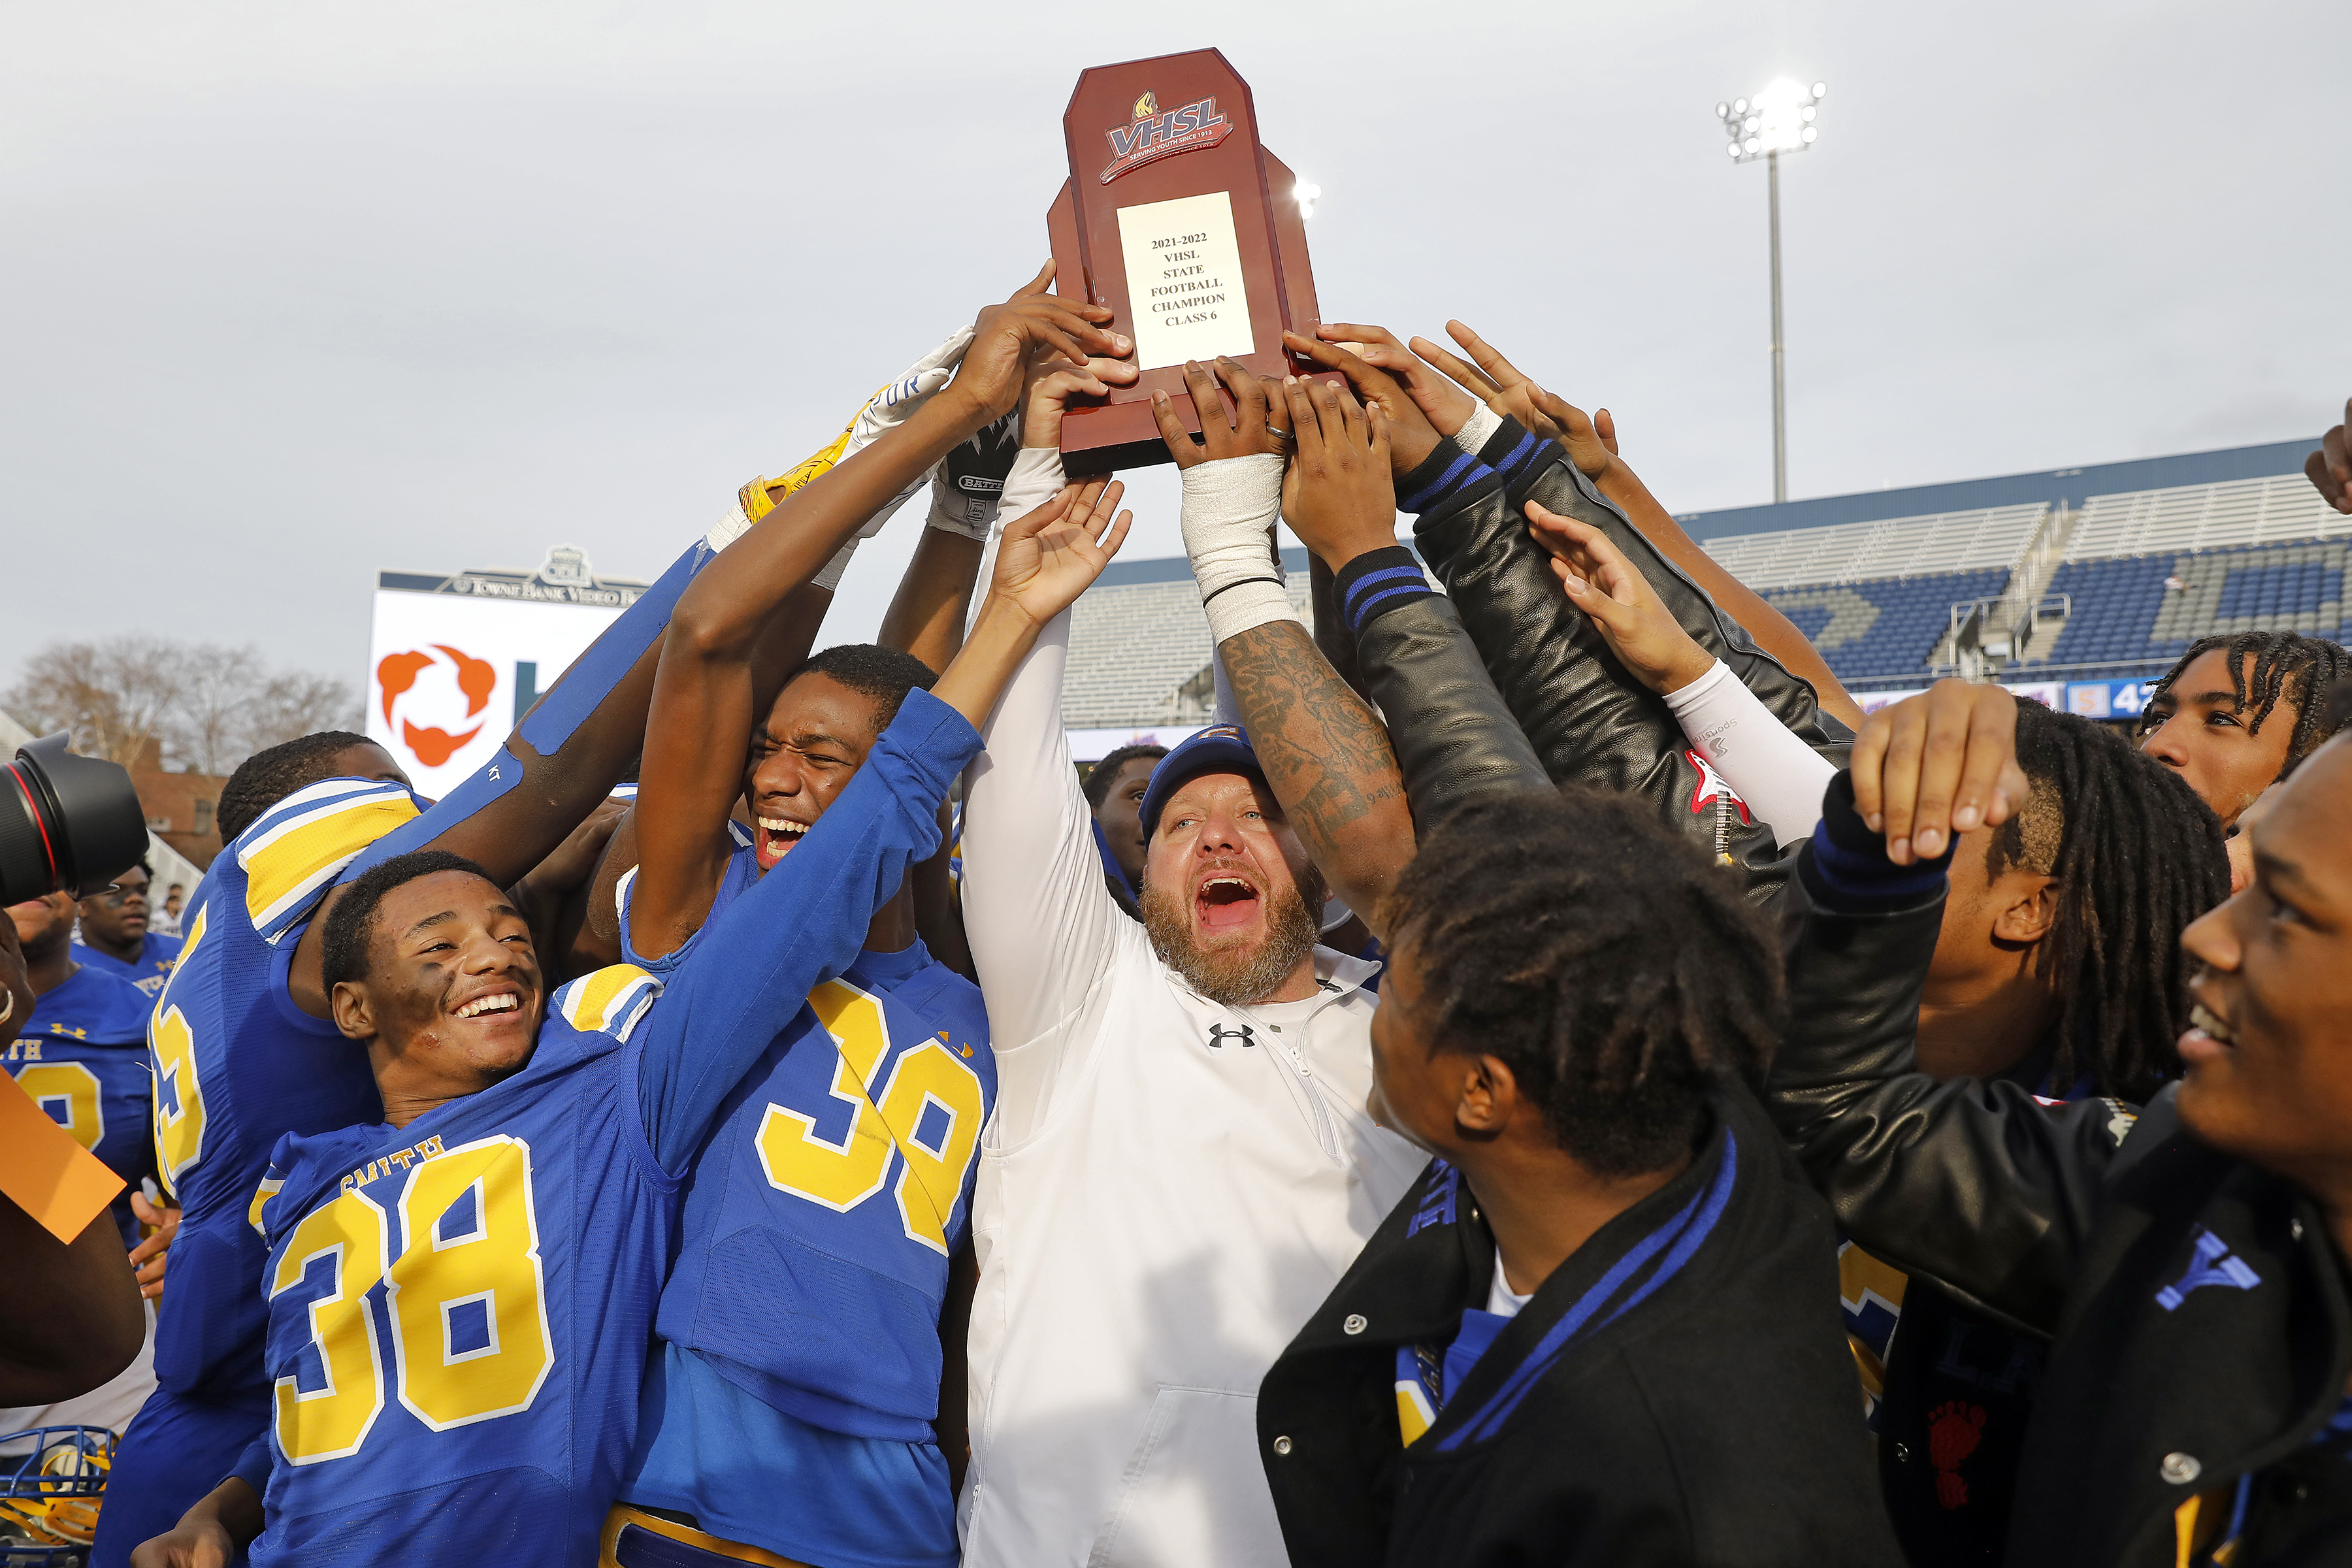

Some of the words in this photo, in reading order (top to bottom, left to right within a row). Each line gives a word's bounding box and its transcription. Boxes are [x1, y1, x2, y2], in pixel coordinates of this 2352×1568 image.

[1111, 99, 1224, 156] VHSL
[1130, 147, 1156, 161] SERVING
[1156, 138, 1179, 151] YOUTH
[1179, 133, 1197, 144] SINCE
[1197, 129, 1213, 138] 1913
[1151, 233, 1207, 250] 2021-2022
[1164, 250, 1200, 263] VHSL
[1163, 265, 1205, 279] STATE
[1151, 278, 1223, 297] FOOTBALL
[1152, 293, 1226, 312] CHAMPION
[1166, 312, 1207, 327] CLASS
[1211, 310, 1217, 319] 6
[964, 478, 1003, 489] BATTL
[0, 1038, 43, 1060] TH
[147, 899, 208, 1200] 5
[340, 1134, 446, 1196] SMITH
[269, 1134, 555, 1466] 38
